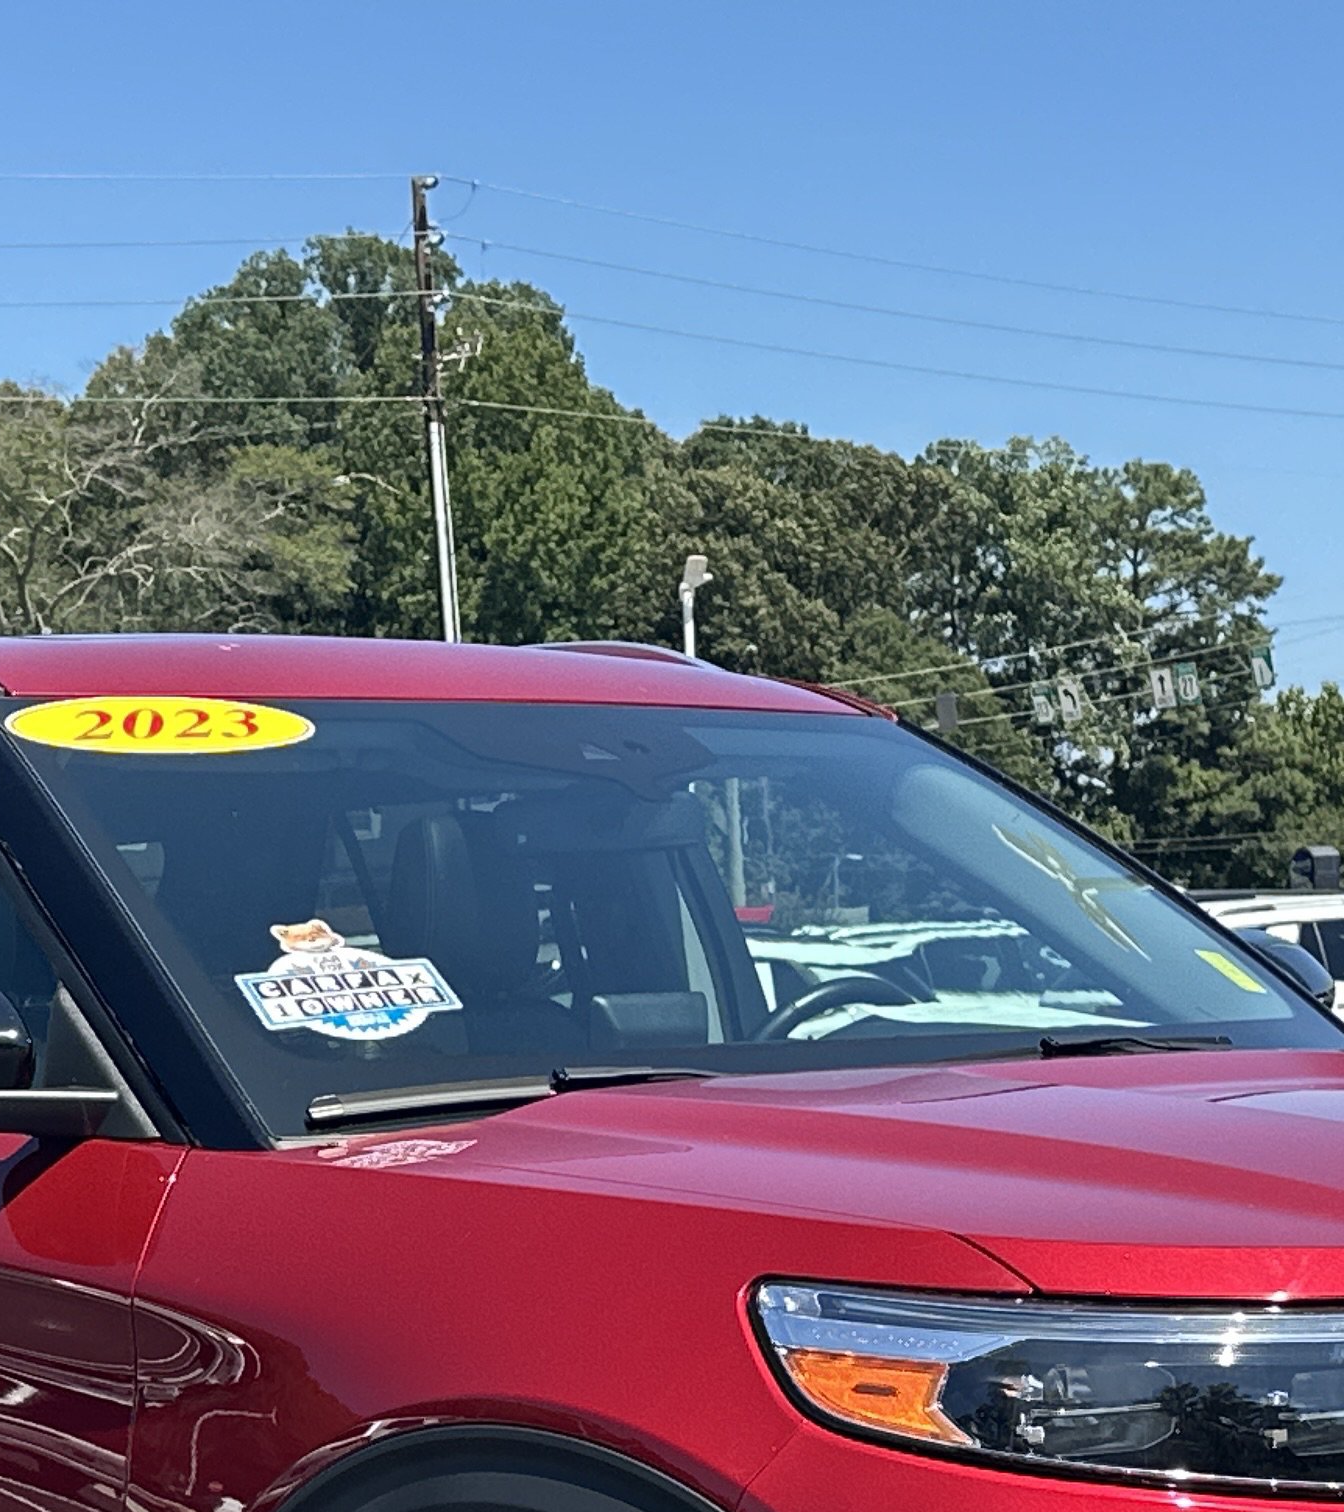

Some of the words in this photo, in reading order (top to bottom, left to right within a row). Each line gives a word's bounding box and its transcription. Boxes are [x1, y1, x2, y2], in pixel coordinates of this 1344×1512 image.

[73, 708, 259, 741] 2023
[255, 969, 428, 998] CARFAX
[296, 986, 447, 1017] OWNER
